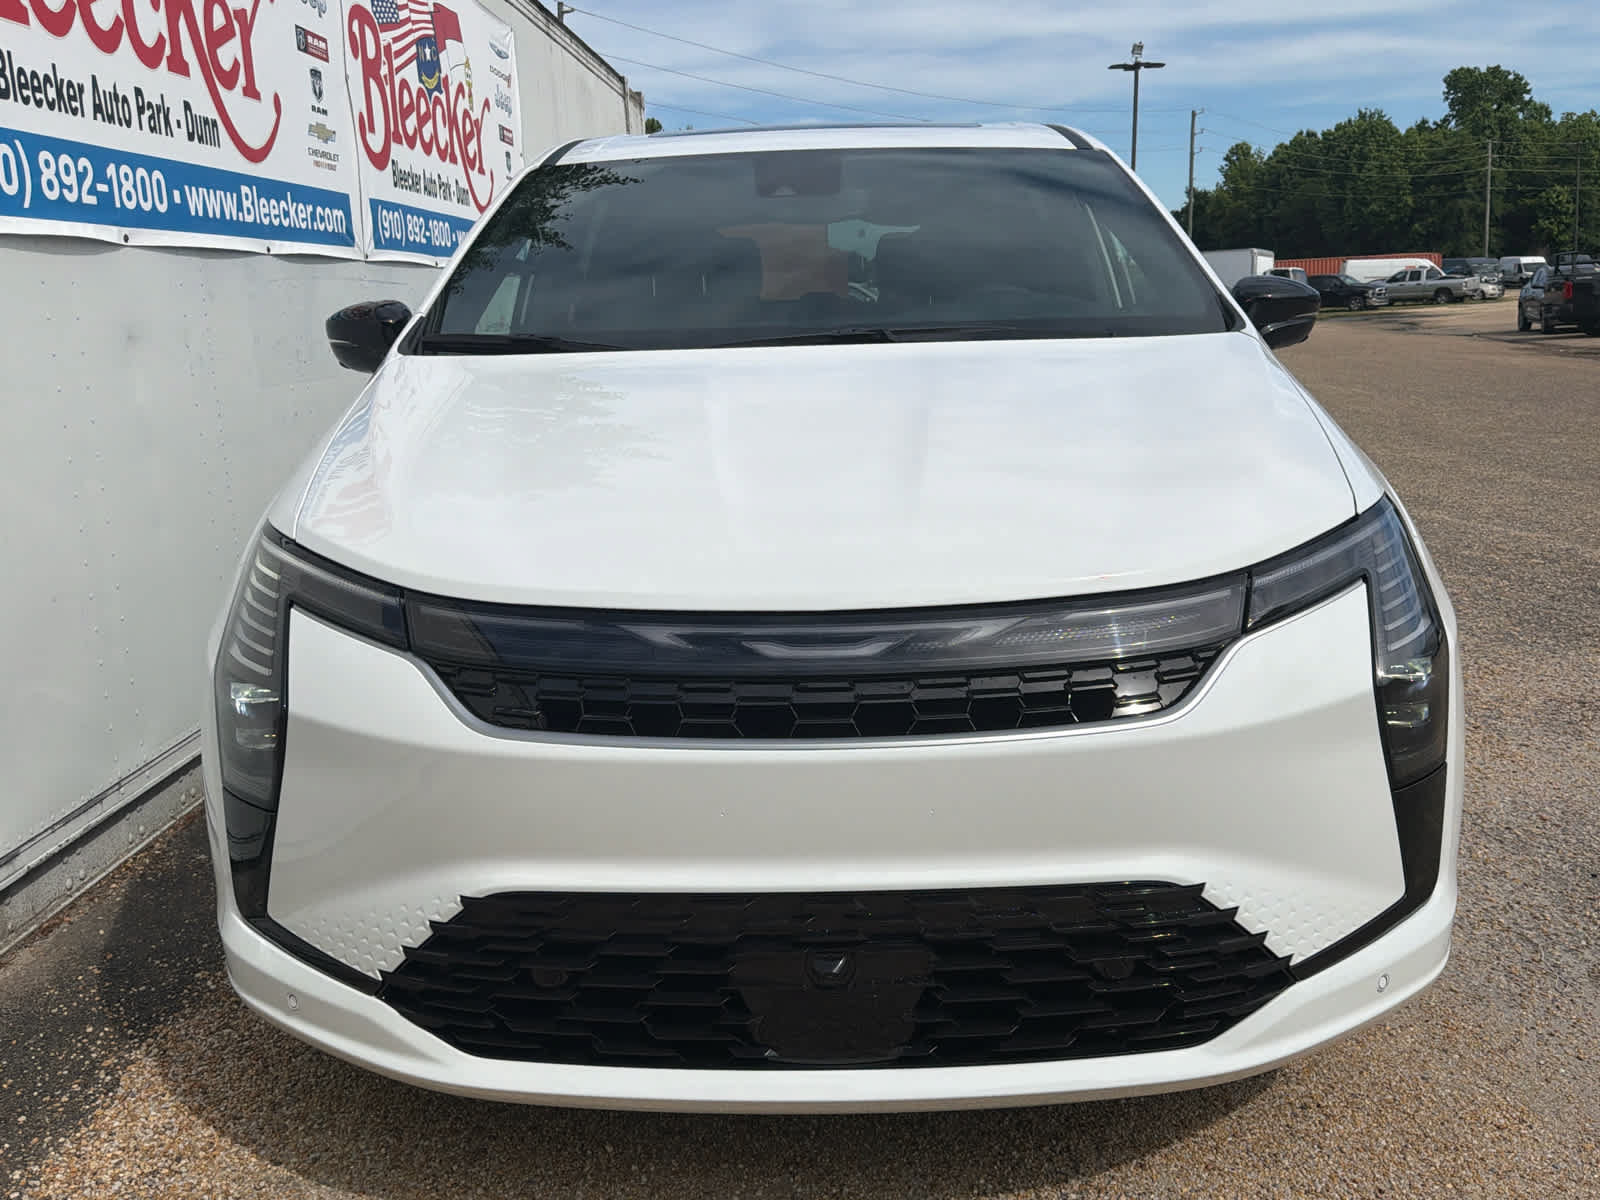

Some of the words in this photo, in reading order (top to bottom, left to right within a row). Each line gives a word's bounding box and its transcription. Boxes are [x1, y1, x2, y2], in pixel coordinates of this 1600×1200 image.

[91, 74, 132, 129] Auto
[134, 86, 174, 138] Park
[183, 100, 221, 148] Dunn
[311, 105, 328, 116] RAM
[347, 3, 494, 214] Bleecker
[307, 147, 340, 162] CHEVROLET
[38, 150, 168, 213] 892-1800
[184, 184, 347, 234] www.Bleecker.com
[391, 159, 421, 194] Bleecker
[423, 168, 438, 199] Auto
[438, 173, 453, 201] Park
[455, 179, 470, 207] Dunn
[377, 205, 406, 247] (910)
[406, 214, 452, 248] 892-1800
